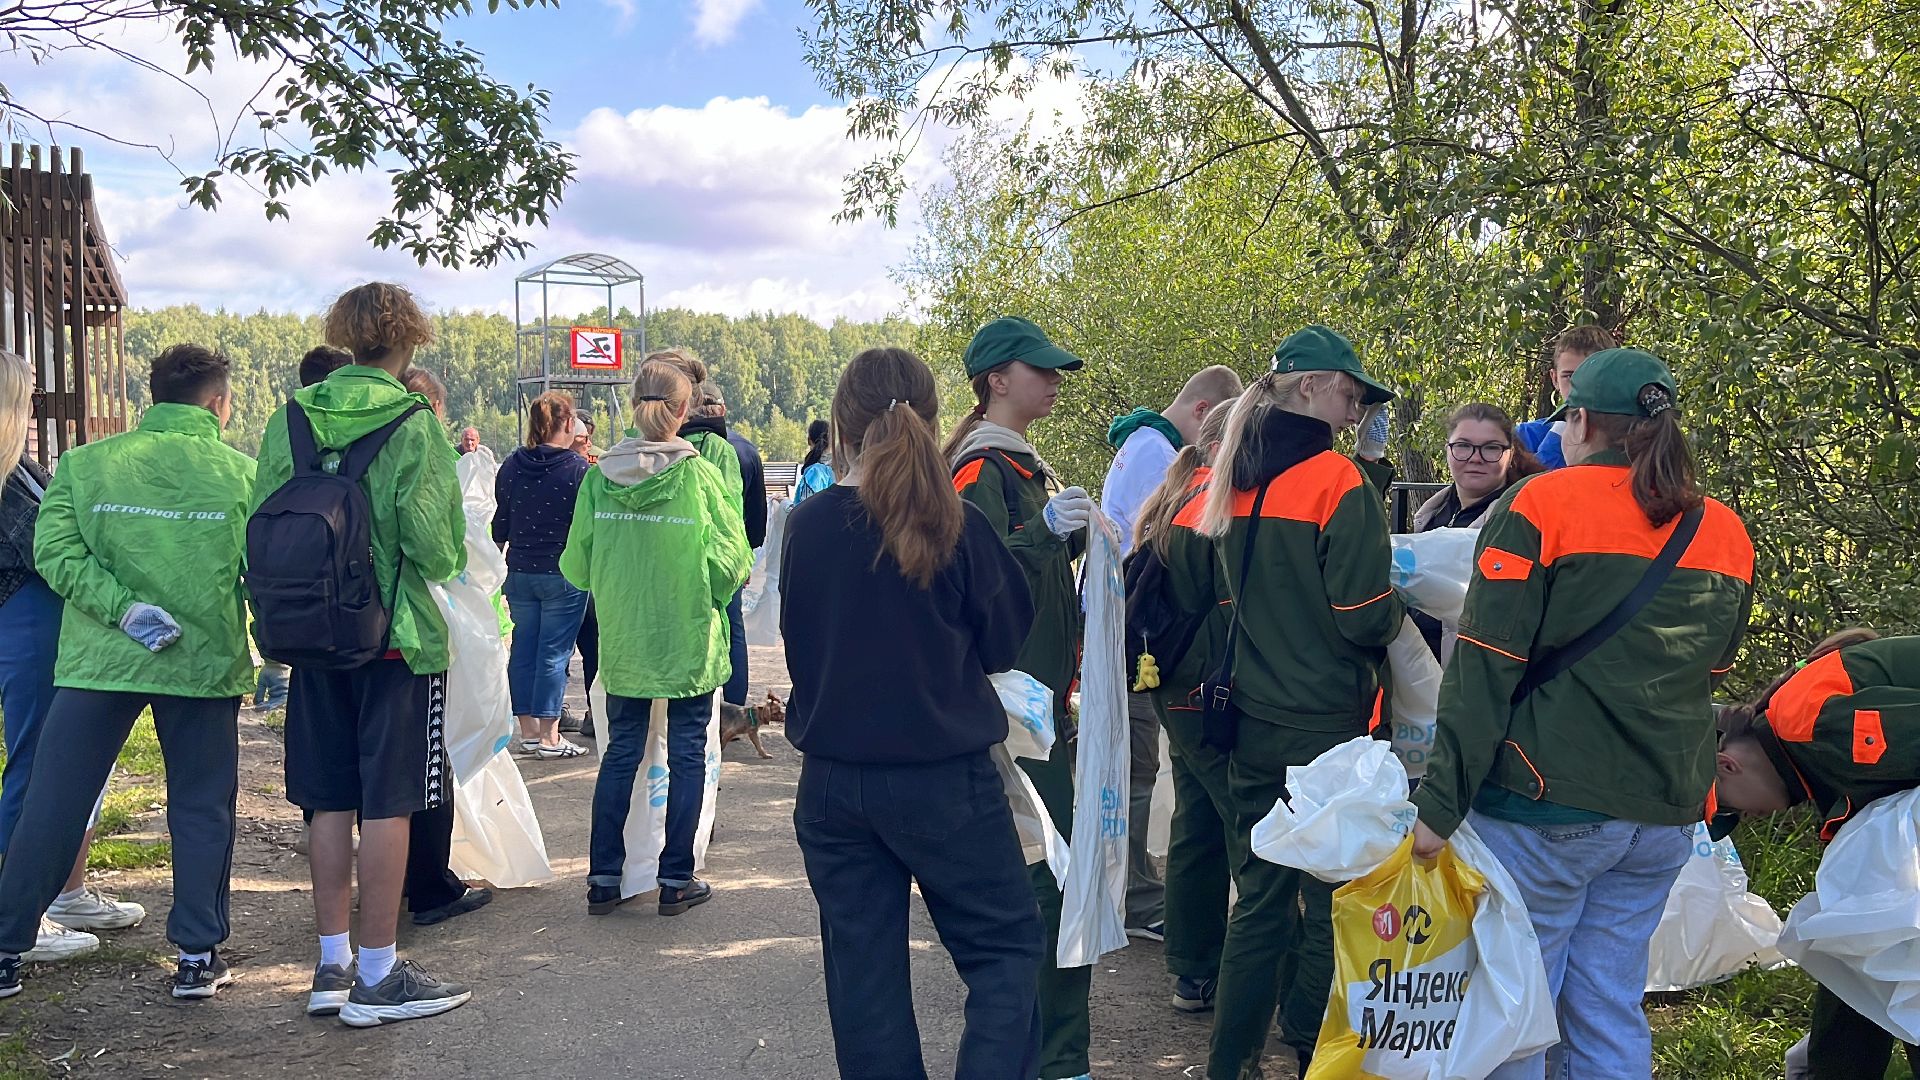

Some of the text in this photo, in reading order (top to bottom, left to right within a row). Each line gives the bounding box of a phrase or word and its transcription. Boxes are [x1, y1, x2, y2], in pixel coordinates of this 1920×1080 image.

[93, 503, 226, 520] ВОСТОЧНОЕ ГОСБ
[594, 511, 664, 523] ВОСТОЧНОЕ
[1365, 958, 1469, 1009] Яндекс
[1356, 1006, 1457, 1059] Марке
